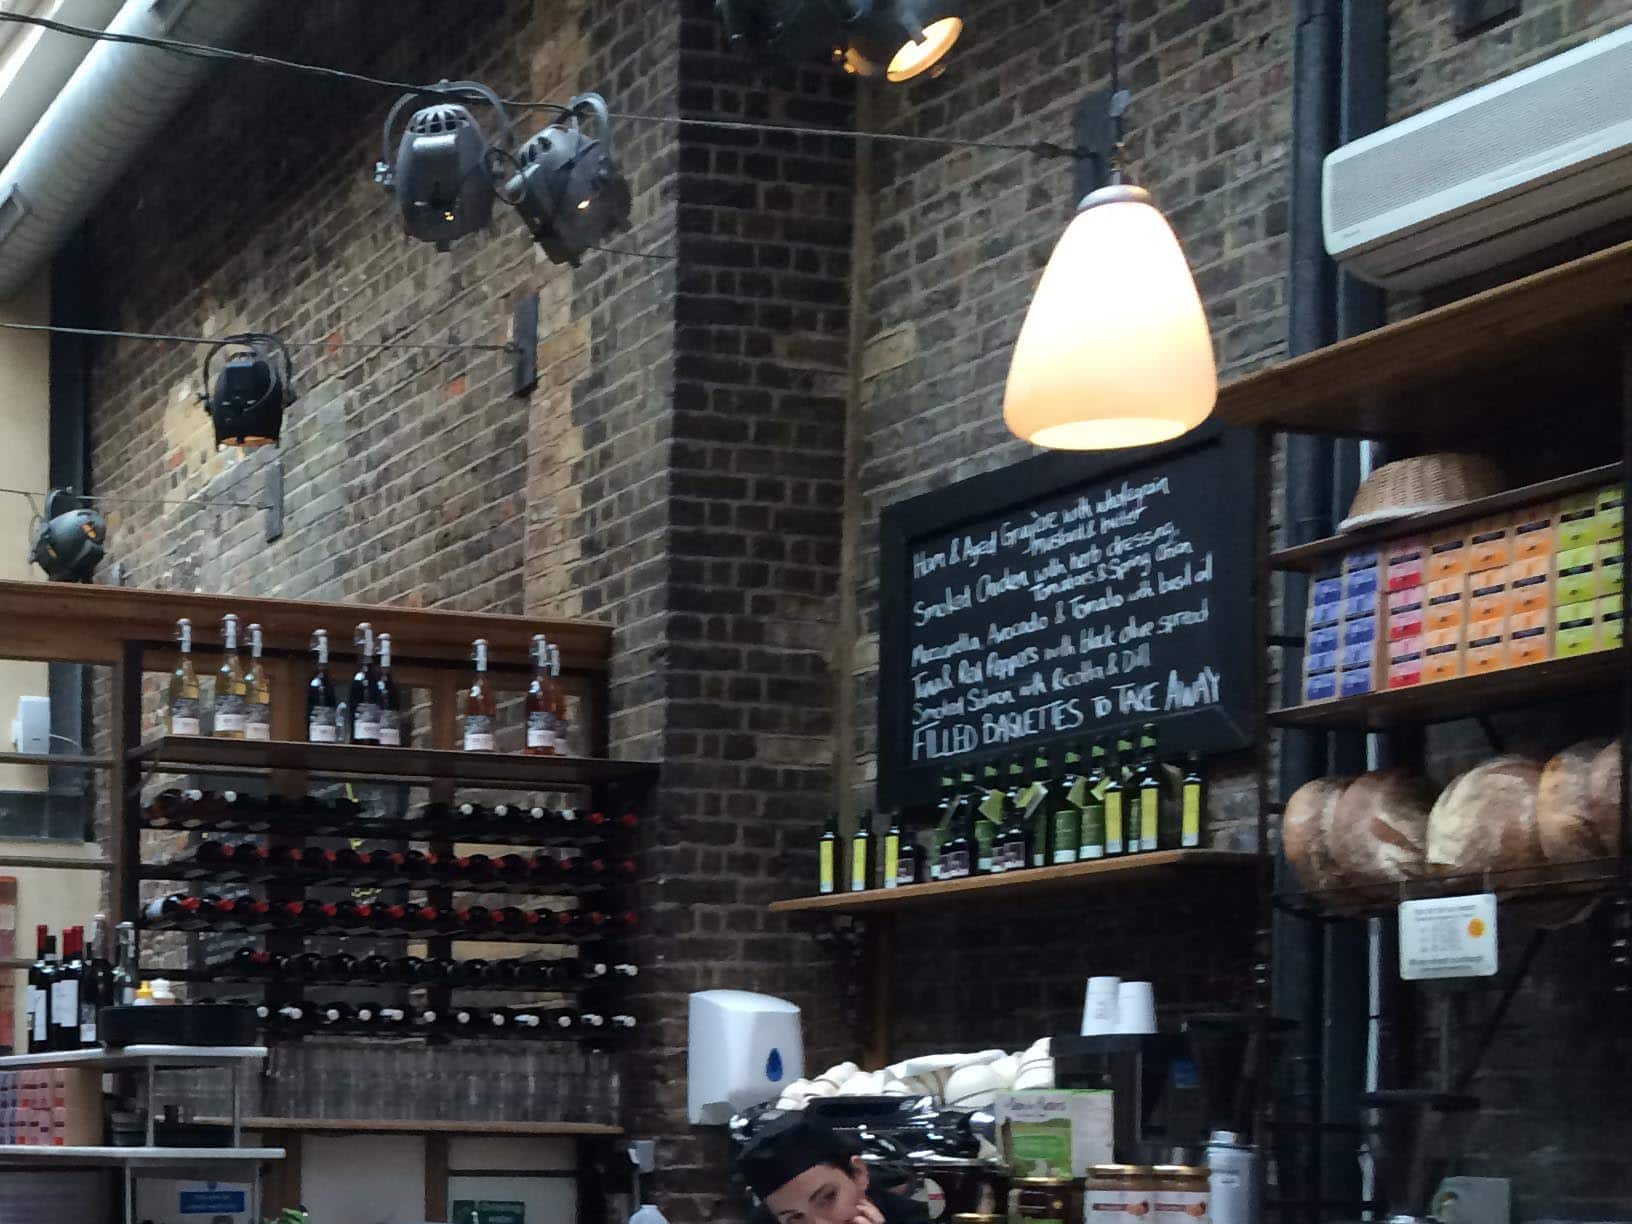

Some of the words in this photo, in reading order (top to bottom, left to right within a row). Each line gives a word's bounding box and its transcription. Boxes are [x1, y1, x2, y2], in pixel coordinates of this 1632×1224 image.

[1062, 496, 1093, 523] with
[913, 584, 972, 626] Smoked
[976, 567, 1030, 603] Chicken
[1033, 558, 1067, 583] with
[1068, 586, 1124, 620] Tomato
[912, 720, 979, 761] FILLED
[981, 698, 1084, 746] BAGUETTES
[1091, 695, 1113, 718] TO
[1109, 682, 1161, 715] TAKE
[1164, 666, 1221, 712] AWAY
